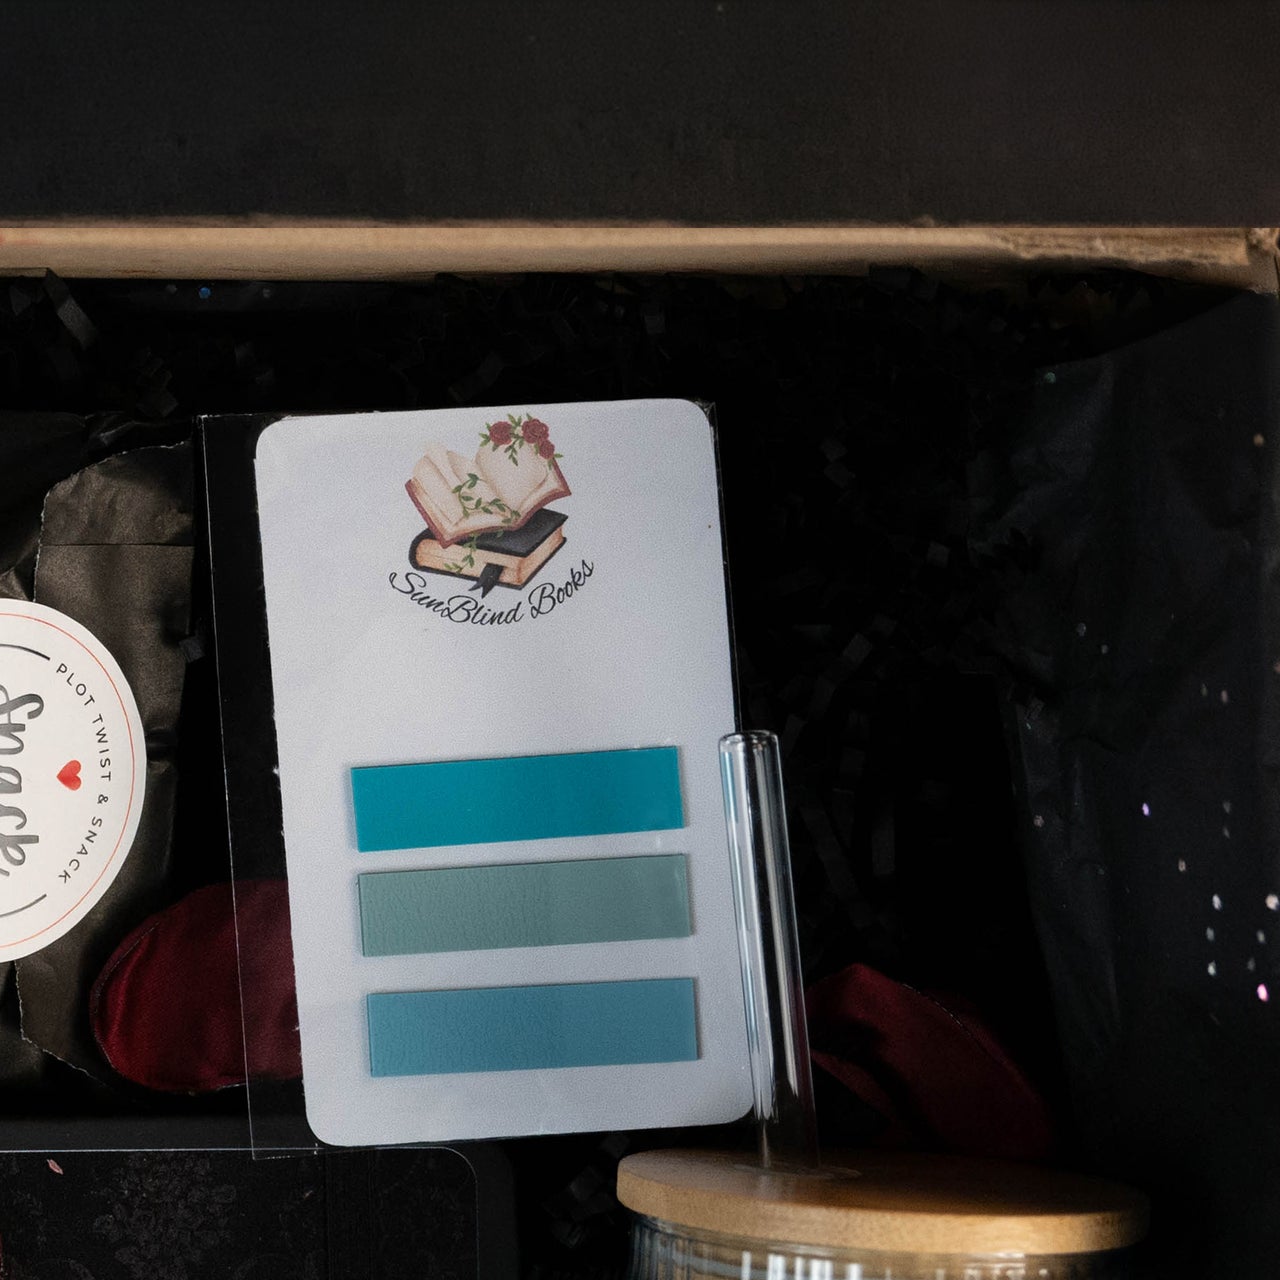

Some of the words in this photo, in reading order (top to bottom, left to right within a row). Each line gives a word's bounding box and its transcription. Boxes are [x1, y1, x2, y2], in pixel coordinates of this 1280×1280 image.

[389, 572, 524, 625] SunBlind
[528, 559, 594, 619] Books
[55, 663, 95, 706] PLOT
[91, 713, 111, 781] TWIST
[97, 794, 109, 804] &
[57, 816, 103, 883] SNACK
